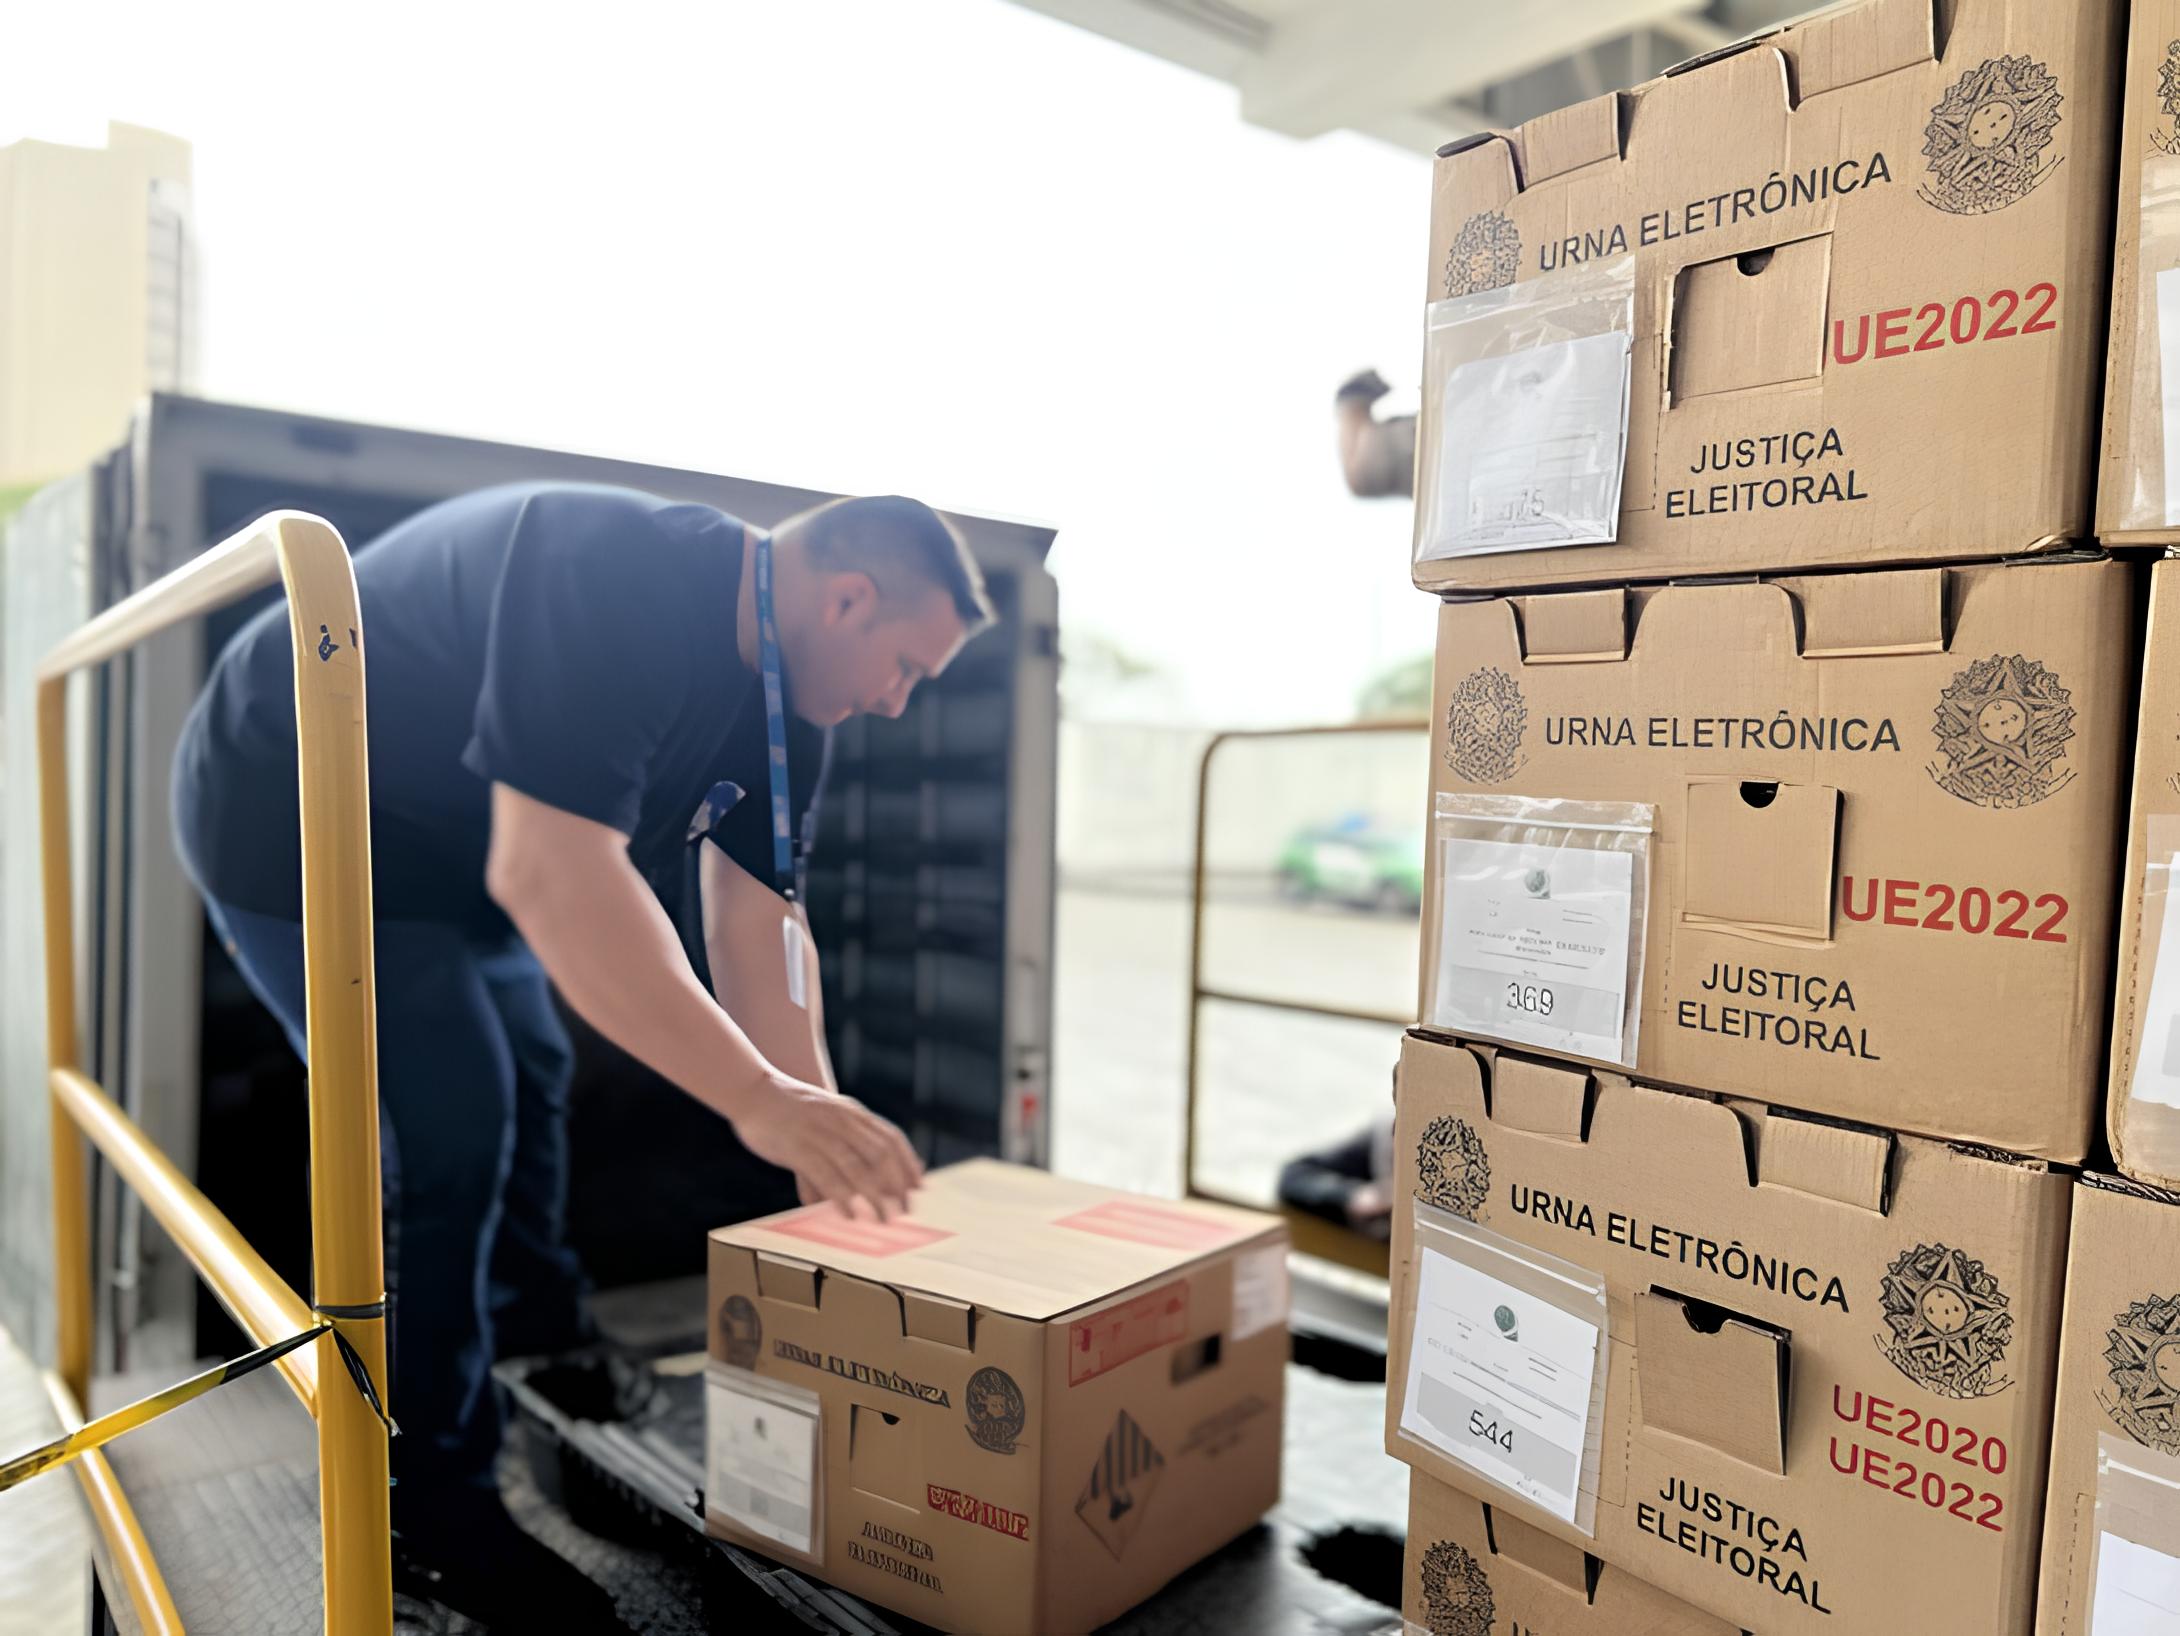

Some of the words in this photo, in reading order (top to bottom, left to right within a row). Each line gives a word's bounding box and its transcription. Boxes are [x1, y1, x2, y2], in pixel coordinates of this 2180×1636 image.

[1539, 224, 1629, 271] URNA
[1832, 282, 2059, 365] UE2022
[1690, 427, 1844, 474] JUSTIÇA
[1666, 469, 1869, 518] ELEITORAL
[1546, 716, 1637, 747] URNA
[1647, 709, 1901, 752] ELETRÔNICA
[1842, 876, 2070, 944] UE2022
[1701, 963, 1856, 1012] JUSTIÇA
[1677, 1000, 1881, 1061] ELEITORAL
[1511, 1183, 1597, 1237] URNA
[1606, 1211, 1850, 1314] ELETRÔNICA
[1468, 1409, 1513, 1454] 544
[1833, 1384, 2008, 1475] UE2020
[1829, 1436, 2004, 1533] UE2022
[1659, 1476, 1808, 1563] JUSTIÇA
[1637, 1502, 1833, 1616] ELEITORAL
